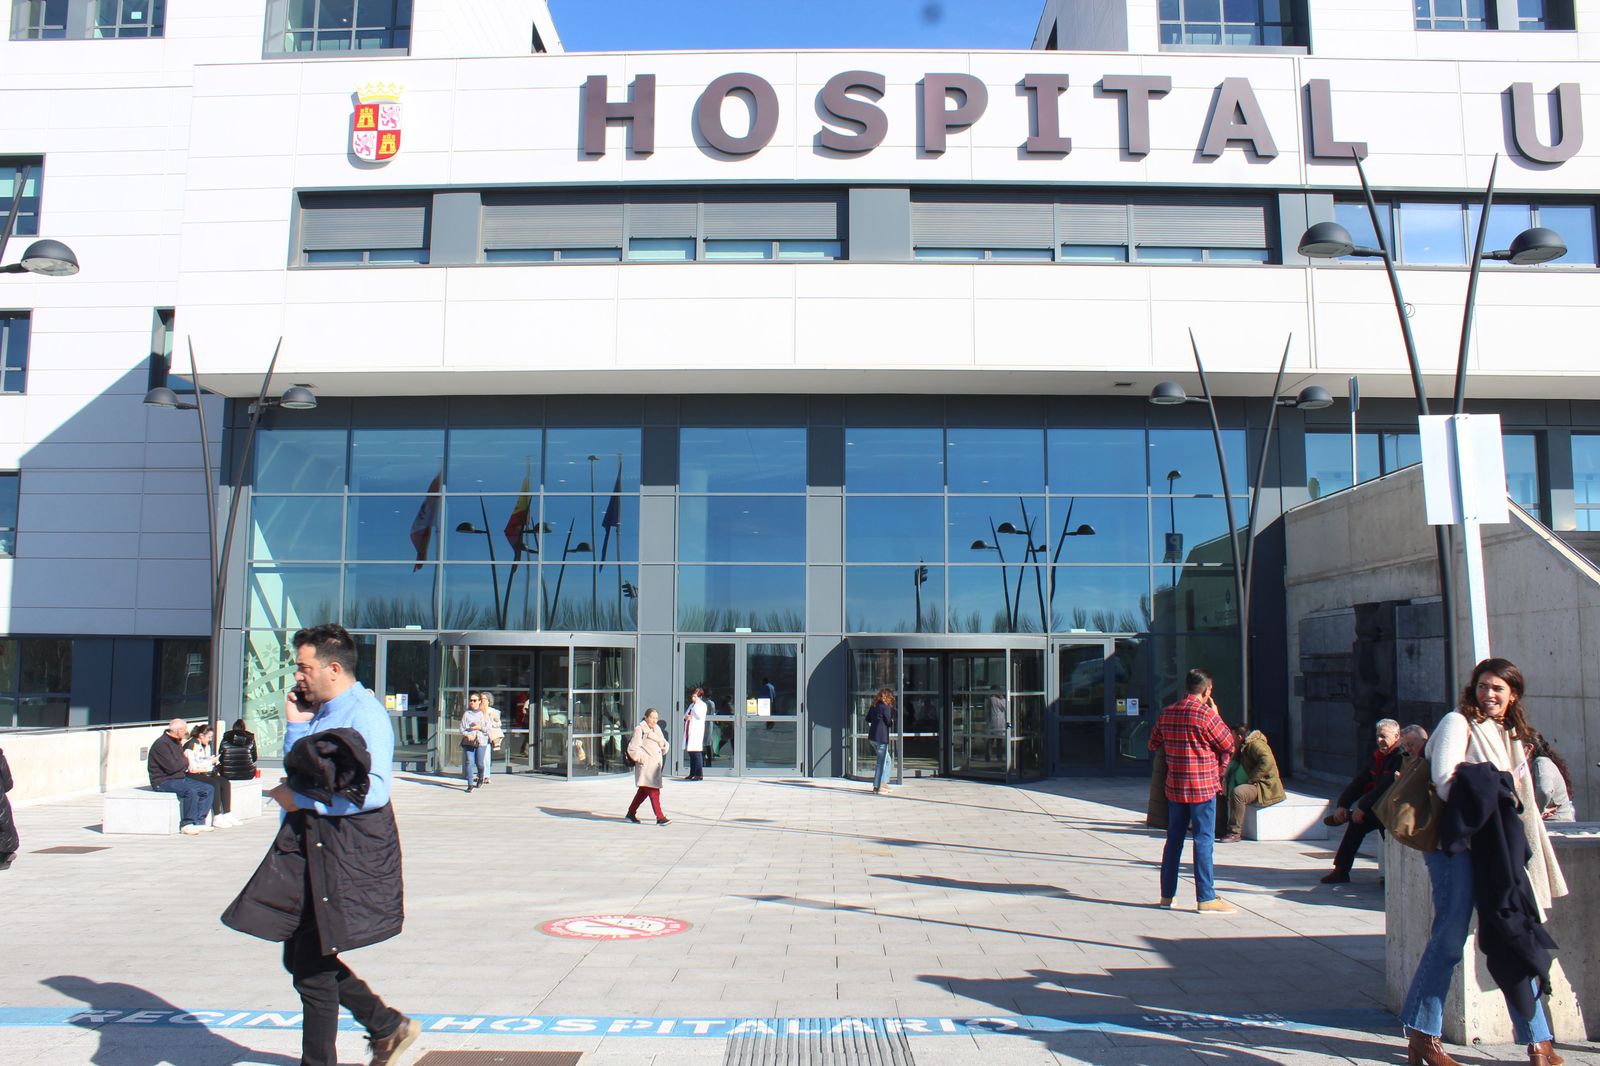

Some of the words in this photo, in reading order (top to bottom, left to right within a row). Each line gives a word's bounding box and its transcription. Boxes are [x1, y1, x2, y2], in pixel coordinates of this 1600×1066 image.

[581, 71, 1366, 159] HOSPITAL
[1508, 81, 1584, 164] U
[64, 1009, 366, 1028] RECIN
[430, 1016, 1018, 1034] HOSPITALARIO
